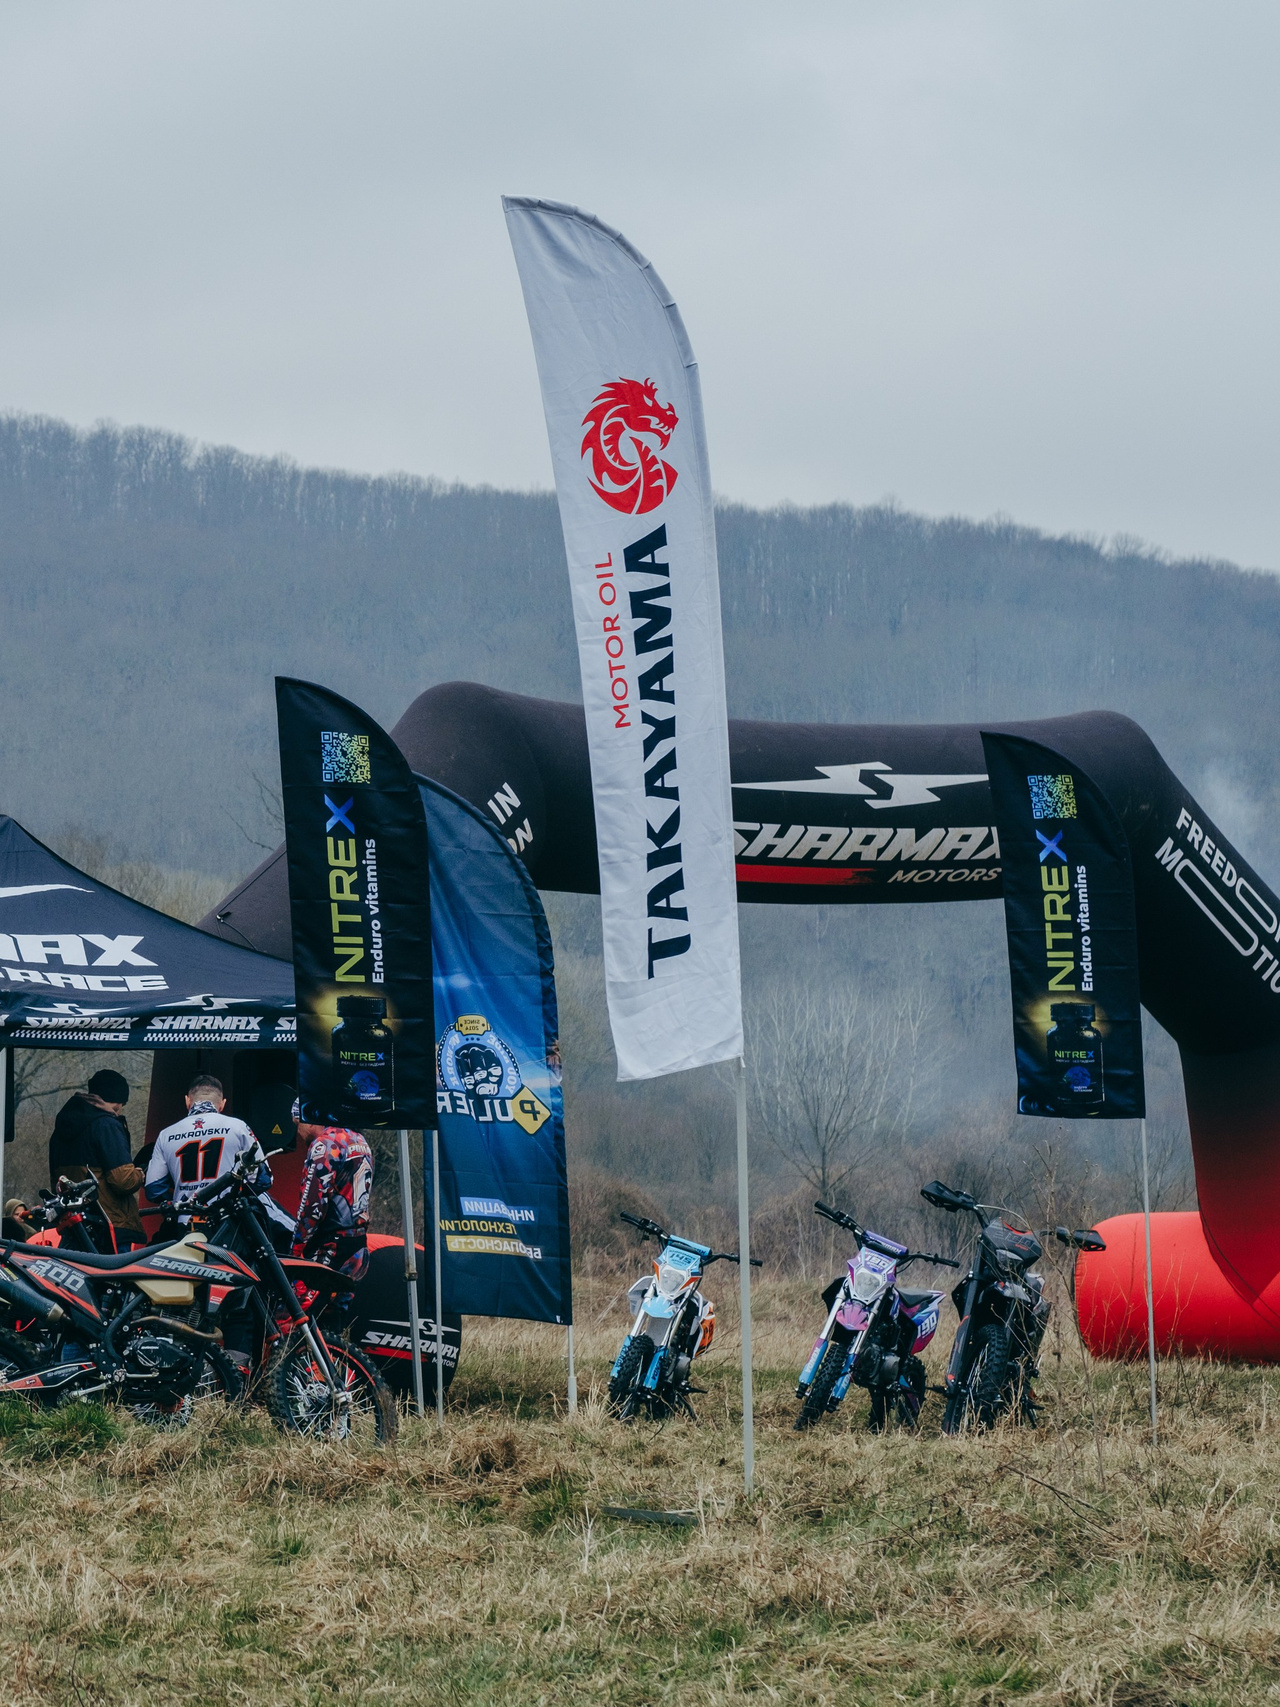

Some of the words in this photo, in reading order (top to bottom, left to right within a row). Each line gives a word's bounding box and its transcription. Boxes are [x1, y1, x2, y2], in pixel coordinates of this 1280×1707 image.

[595, 552, 617, 606] OIL
[603, 613, 631, 728] MOTOR
[623, 523, 691, 979] TAKAYAMA
[487, 782, 521, 825] IN
[324, 794, 366, 983] NITREX
[362, 838, 382, 915] vitamins
[887, 868, 1002, 883] MOTORS
[1175, 807, 1280, 943] FREEDO
[1036, 829, 1076, 992] NITREX
[1074, 865, 1090, 932] vitamins
[370, 920, 384, 983] Enduro
[1081, 935, 1094, 992] Enduro
[3, 966, 169, 992] RACE
[21, 1016, 140, 1030] SHARMAX
[89, 1032, 130, 1042] RACE
[146, 1016, 264, 1031] SHARMAX
[220, 1033, 260, 1042] RACE
[340, 1050, 384, 1061] NITREX
[1055, 1050, 1094, 1058] NITREX
[168, 1128, 231, 1142] POKROVSKIY
[175, 1137, 225, 1183] 11
[35, 1260, 85, 1292] 300
[149, 1257, 234, 1283] SHARMAX
